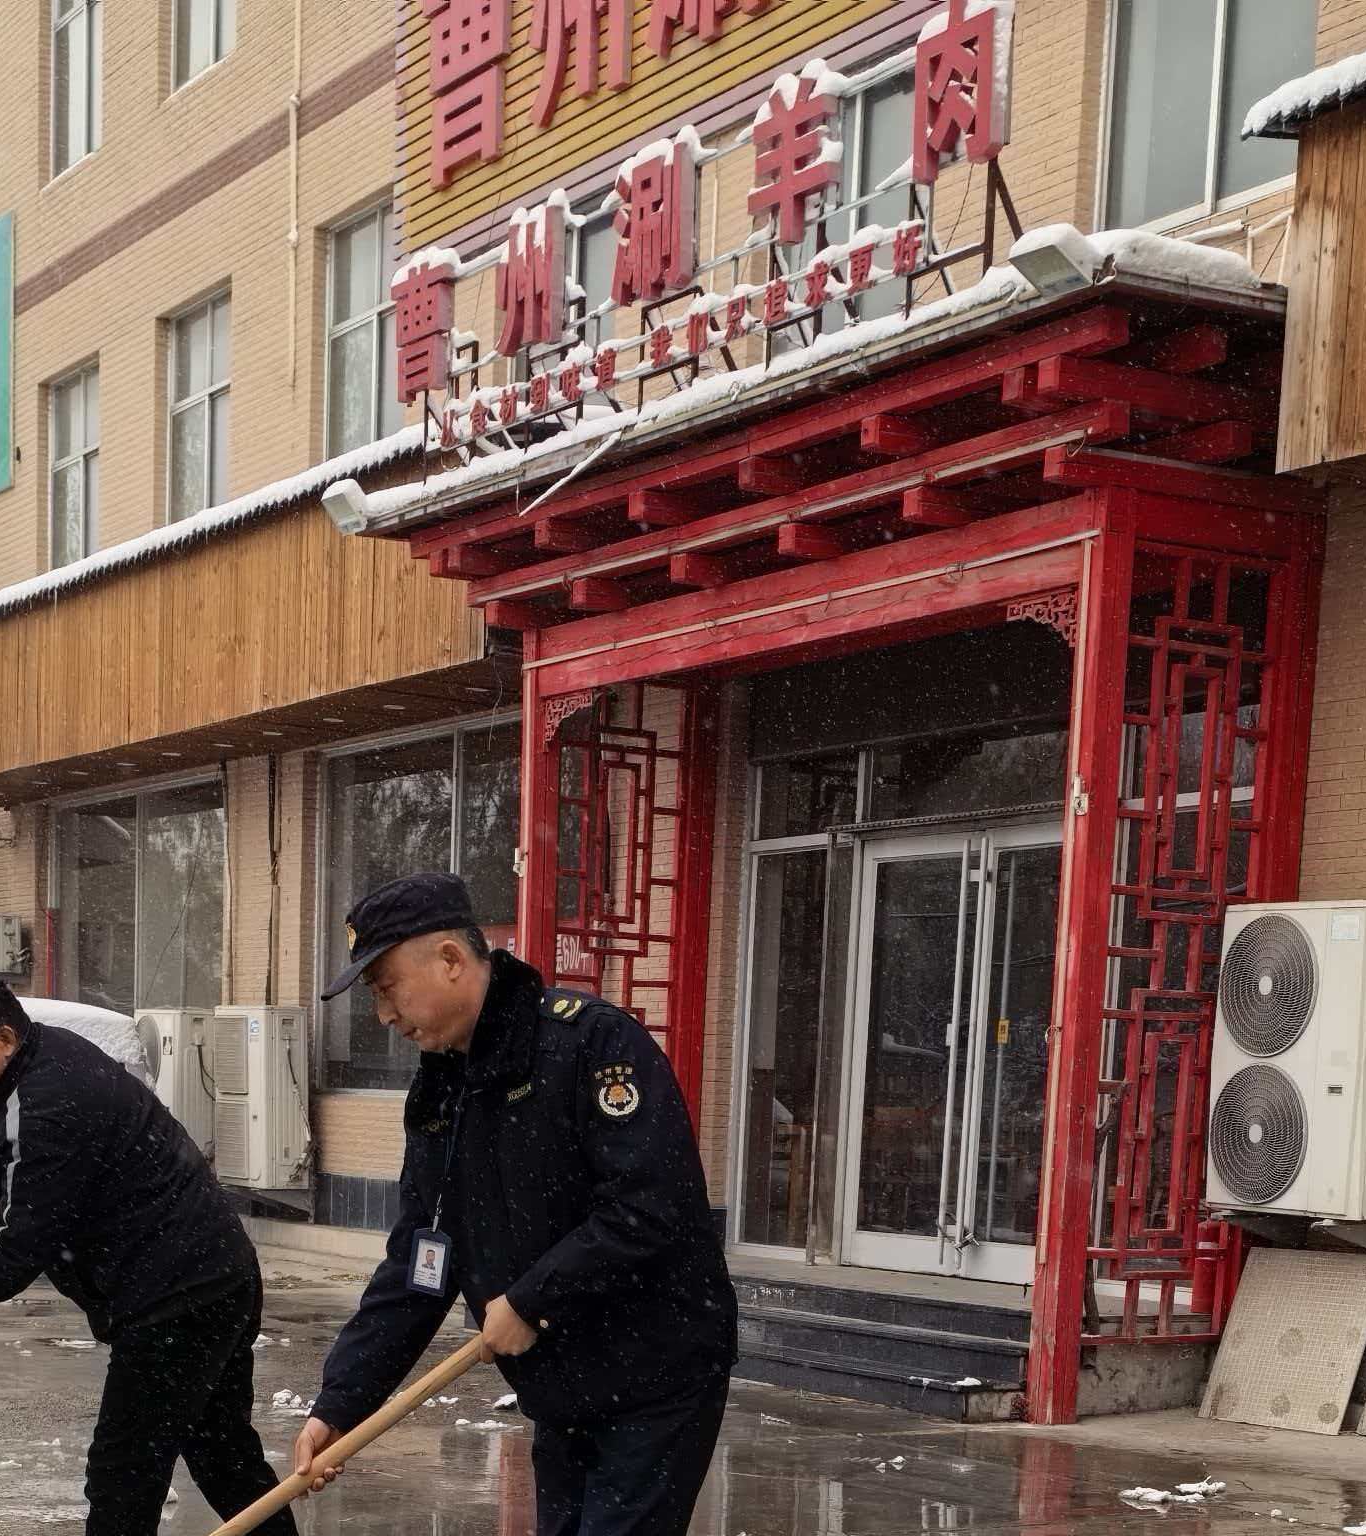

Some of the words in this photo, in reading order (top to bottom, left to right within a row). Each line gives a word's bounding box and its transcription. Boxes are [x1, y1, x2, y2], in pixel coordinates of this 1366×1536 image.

[391, 0, 1010, 404] 曹州涮羊肉
